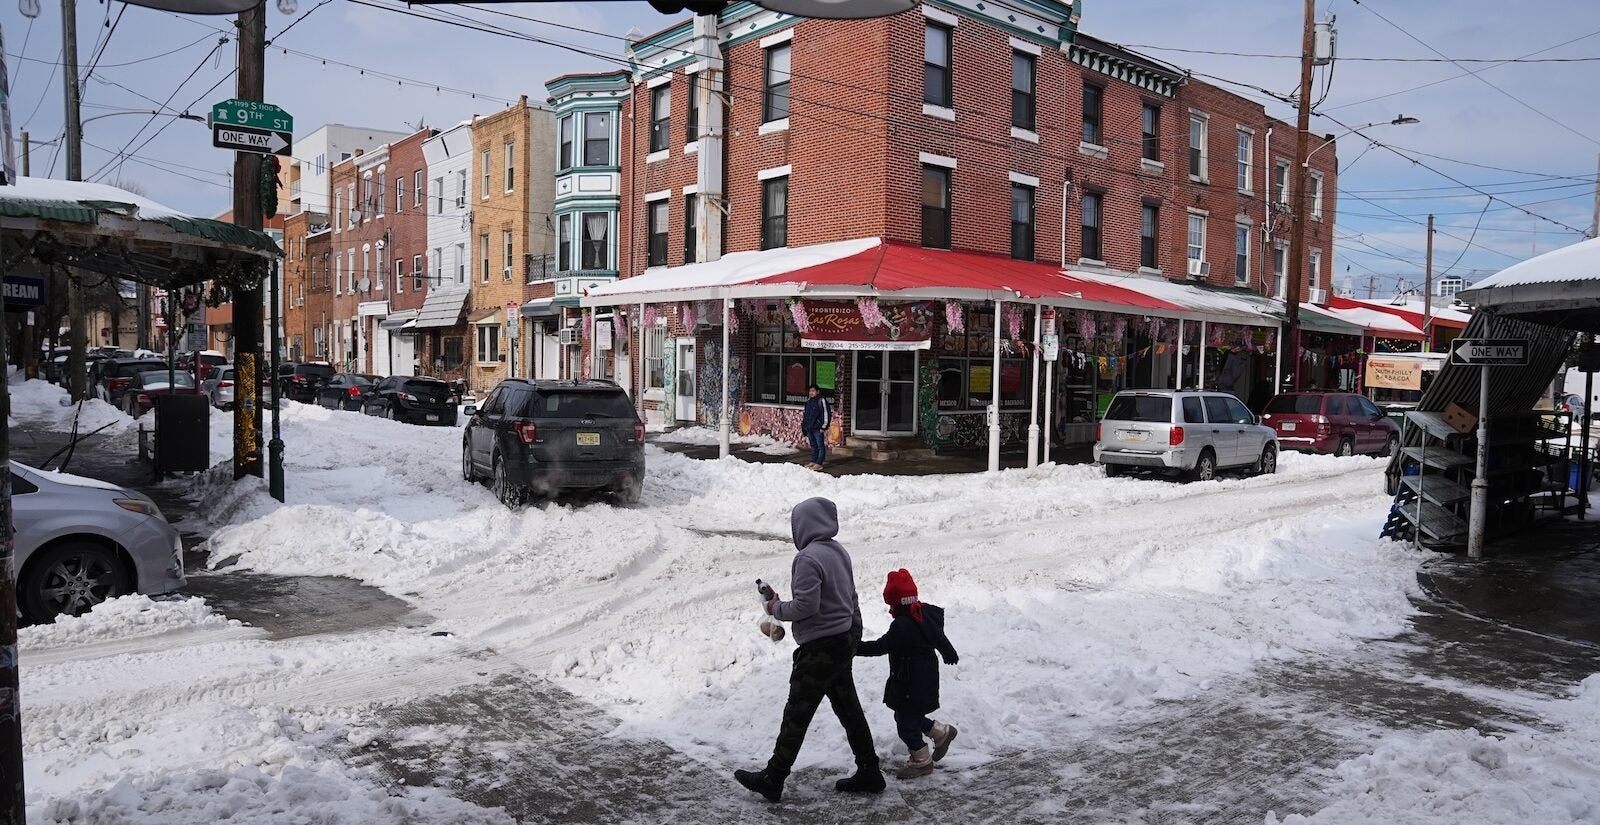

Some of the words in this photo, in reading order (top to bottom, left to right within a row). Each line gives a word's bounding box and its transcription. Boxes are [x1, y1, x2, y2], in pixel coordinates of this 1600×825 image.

[250, 102, 257, 110] S
[258, 104, 273, 112] 1100
[236, 109, 262, 124] 9TH
[273, 118, 289, 130] ST
[222, 131, 245, 144] ONE
[248, 136, 270, 147] WAY
[824, 313, 860, 329] Rosas
[1471, 347, 1492, 357] ONE
[1496, 347, 1520, 357] WAY
